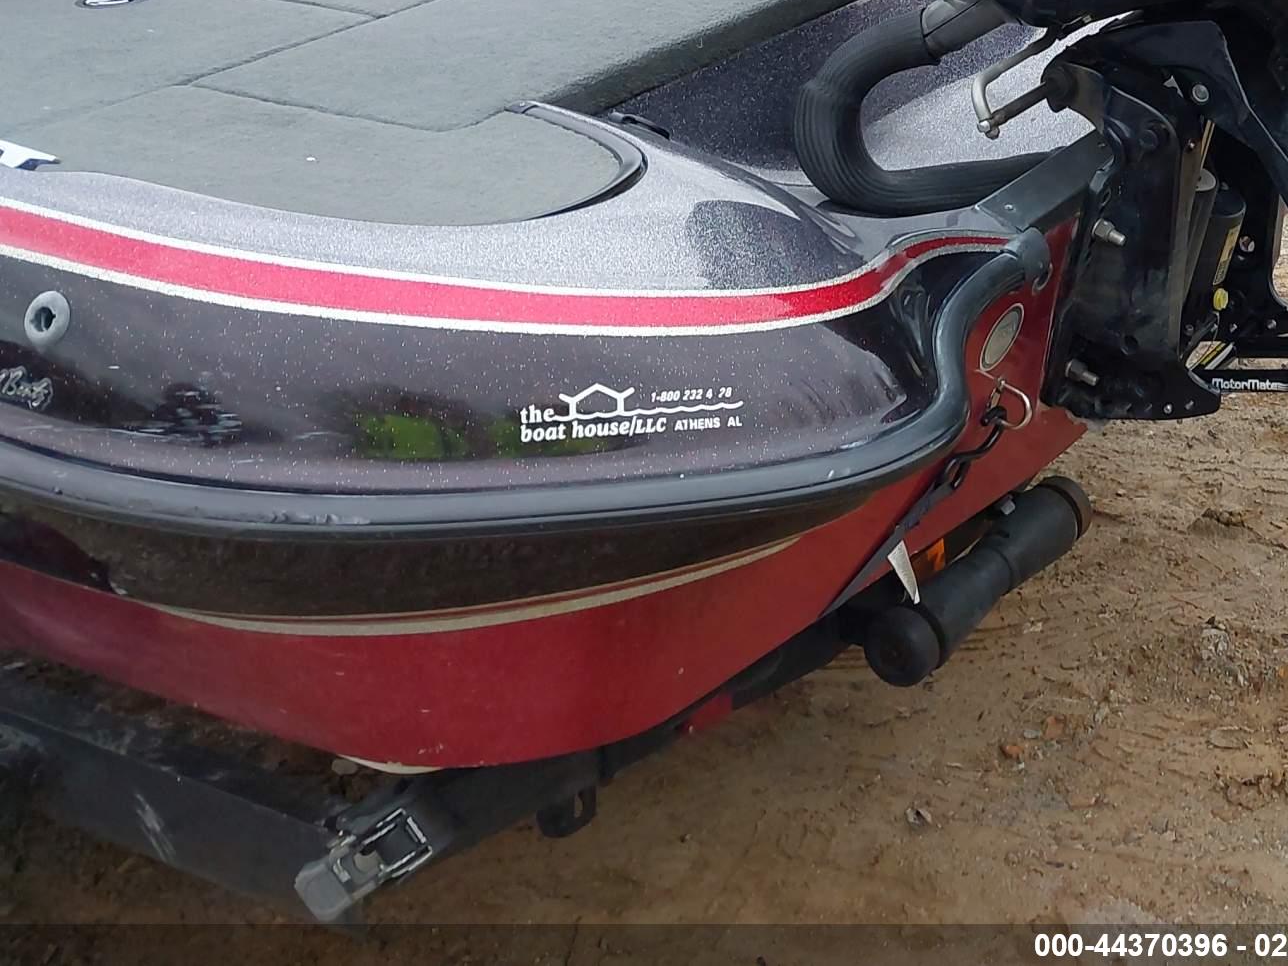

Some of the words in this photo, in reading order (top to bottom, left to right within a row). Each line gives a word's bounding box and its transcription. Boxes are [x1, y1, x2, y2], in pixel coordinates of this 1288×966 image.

[1211, 377, 1280, 391] MotorMate
[650, 390, 681, 403] 1-800
[682, 388, 703, 400] 232
[519, 404, 555, 423] the
[520, 425, 566, 443] boat
[571, 415, 667, 437] house/LLC
[674, 417, 721, 432] ATHENS
[727, 415, 743, 428] AL
